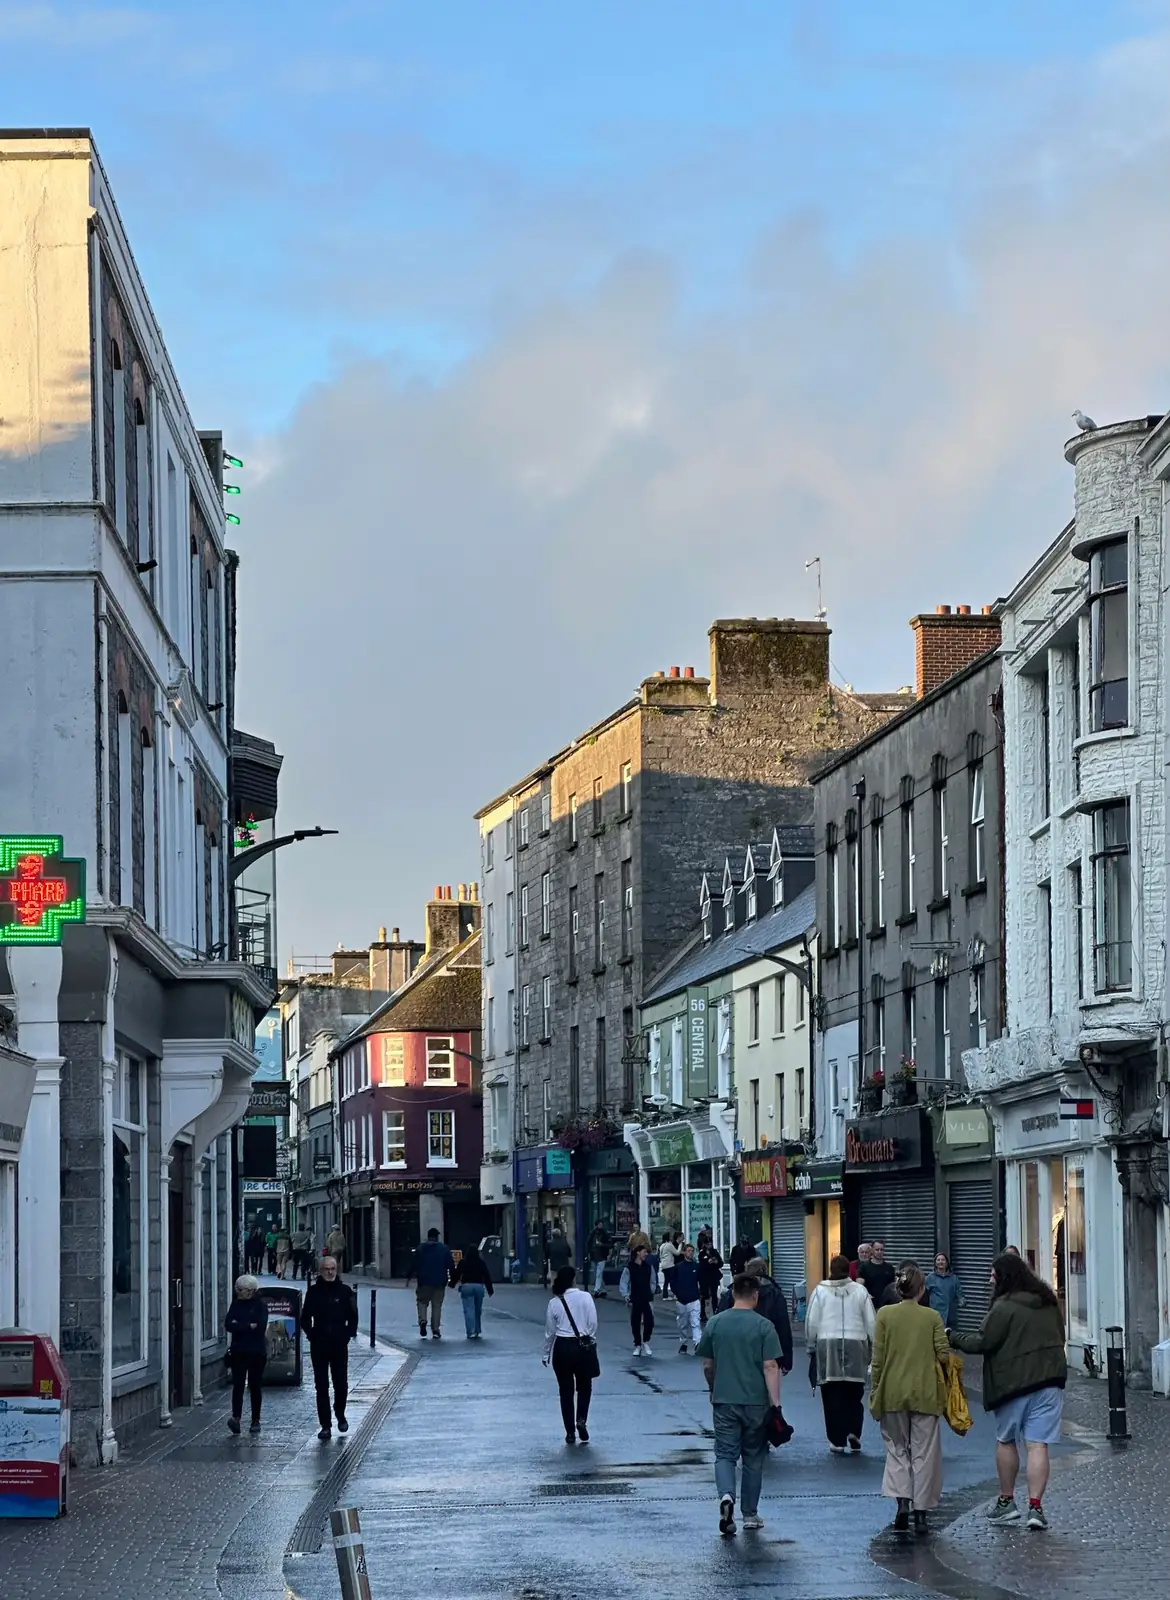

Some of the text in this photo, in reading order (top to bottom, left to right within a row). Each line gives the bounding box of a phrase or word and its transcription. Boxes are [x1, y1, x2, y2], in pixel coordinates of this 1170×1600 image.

[690, 999, 706, 1012] 56
[691, 1017, 705, 1072] CENTRAL
[949, 1121, 985, 1132] VILA
[847, 1127, 895, 1163] Brennans
[795, 1172, 812, 1191] schuh
